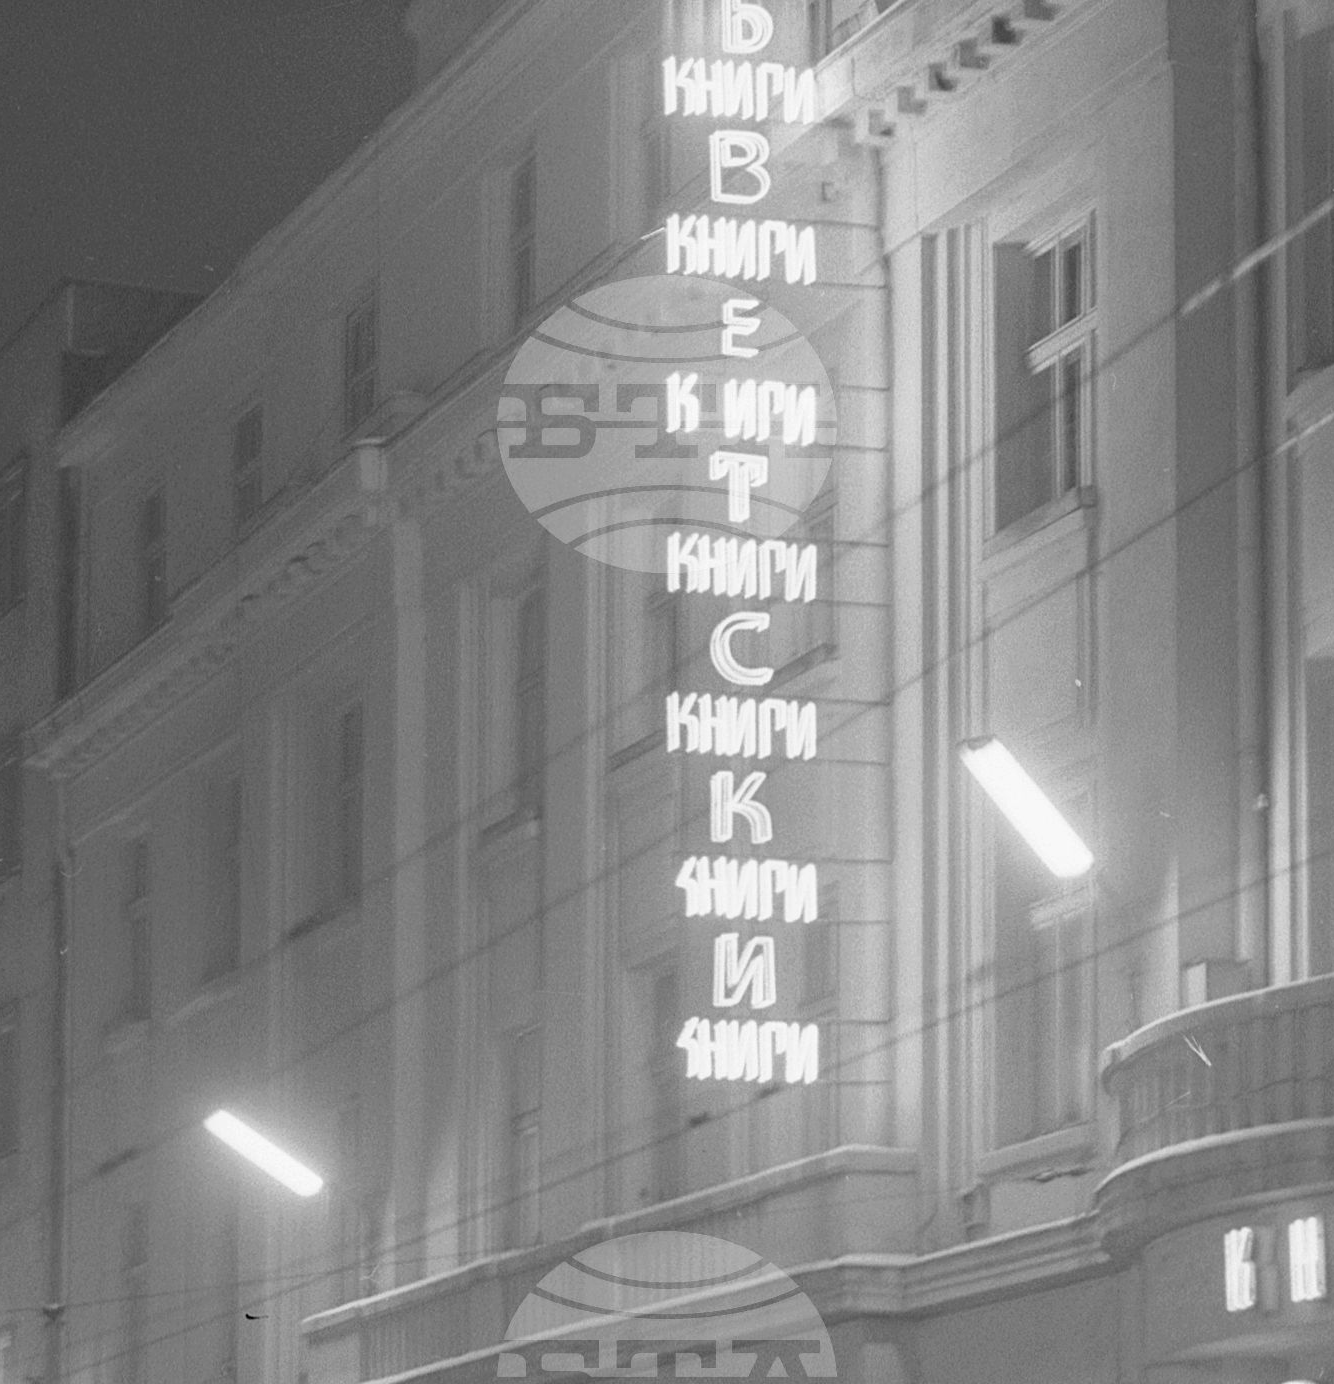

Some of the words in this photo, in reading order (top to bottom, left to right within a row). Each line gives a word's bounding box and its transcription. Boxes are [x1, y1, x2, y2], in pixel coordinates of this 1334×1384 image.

[662, 55, 815, 125] КНИГИ
[666, 213, 816, 286] КНИГИ
[665, 371, 816, 447] КИГИ
[667, 532, 817, 603] КНИГИ
[666, 692, 817, 761] КНИГИ
